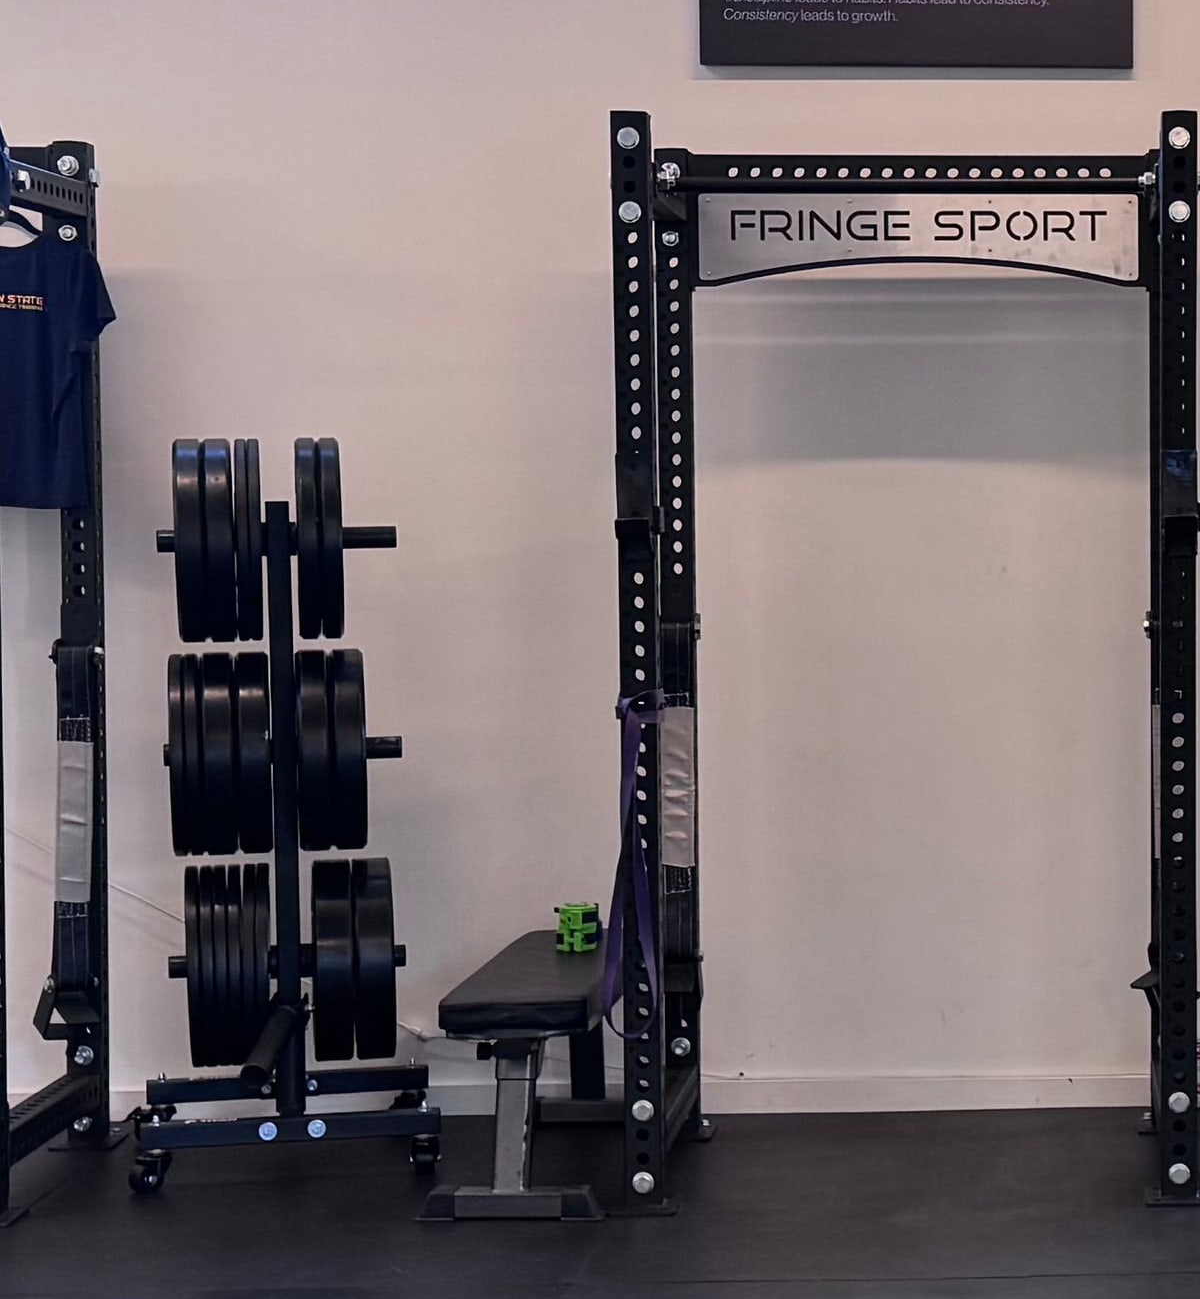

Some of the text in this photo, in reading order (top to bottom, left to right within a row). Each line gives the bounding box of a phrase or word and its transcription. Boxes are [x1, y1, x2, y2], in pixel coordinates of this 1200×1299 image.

[723, 7, 899, 24] Consistency leads to growth.
[730, 209, 1108, 241] FRINGE SPORT
